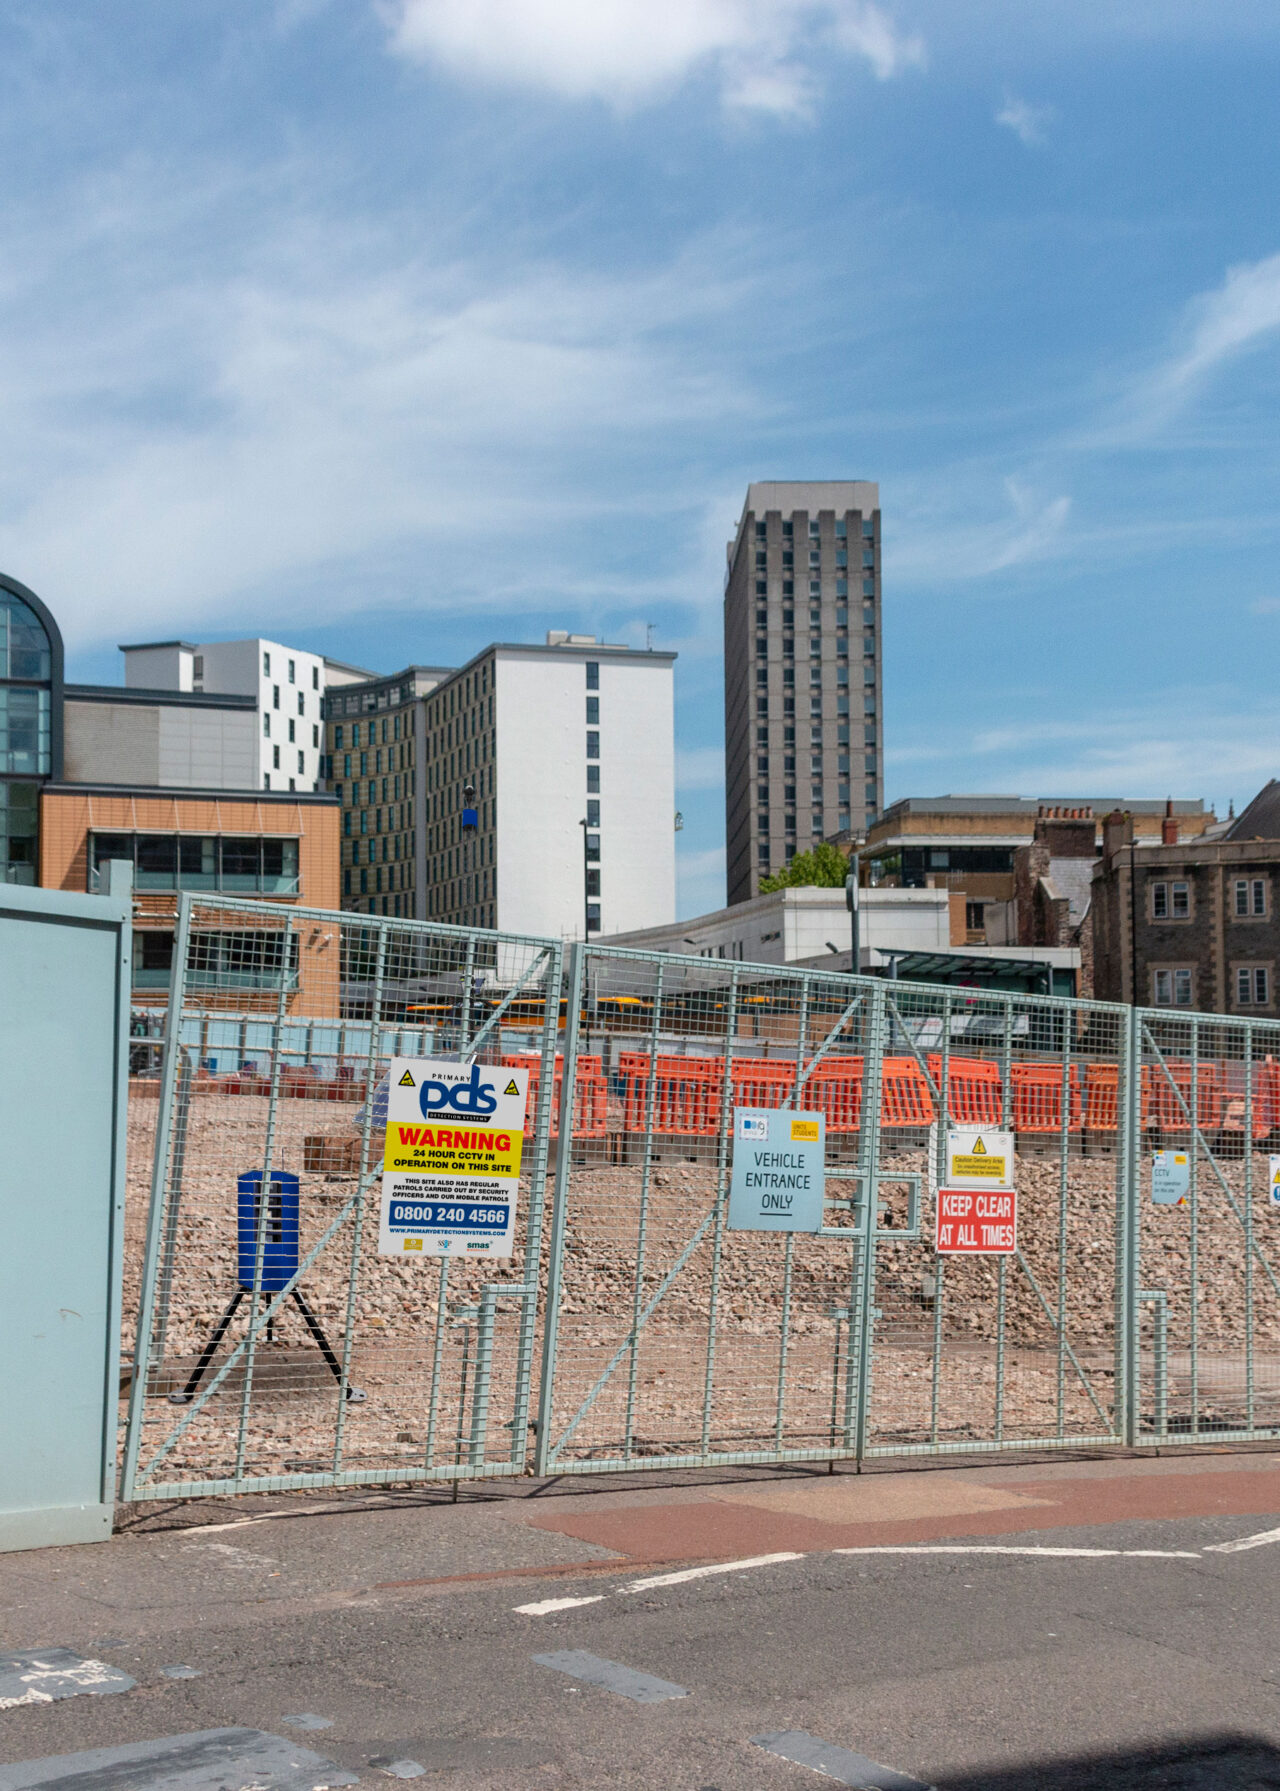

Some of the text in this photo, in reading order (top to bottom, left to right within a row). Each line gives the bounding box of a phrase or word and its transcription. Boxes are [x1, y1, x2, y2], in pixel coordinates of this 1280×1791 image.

[432, 1073, 471, 1082] PRIMARY
[420, 1064, 497, 1120] pds
[398, 1127, 511, 1151] WARNING
[428, 1150, 456, 1159] HOUR
[458, 1152, 483, 1160] CCTV
[485, 1153, 495, 1161] IN
[754, 1152, 805, 1168] VEHICLE
[394, 1159, 512, 1173] OPERATION ON THIS SITE
[745, 1172, 811, 1189] ENTRANCE
[761, 1194, 793, 1209] ONLY
[942, 1195, 1011, 1218] KEEP CLEAR
[394, 1206, 505, 1223] 0800 240 4566
[390, 1228, 506, 1236] WWW.PRIMARYDETECTIONSYSTEMS.COM
[939, 1224, 1014, 1247] AT ALL TIMES
